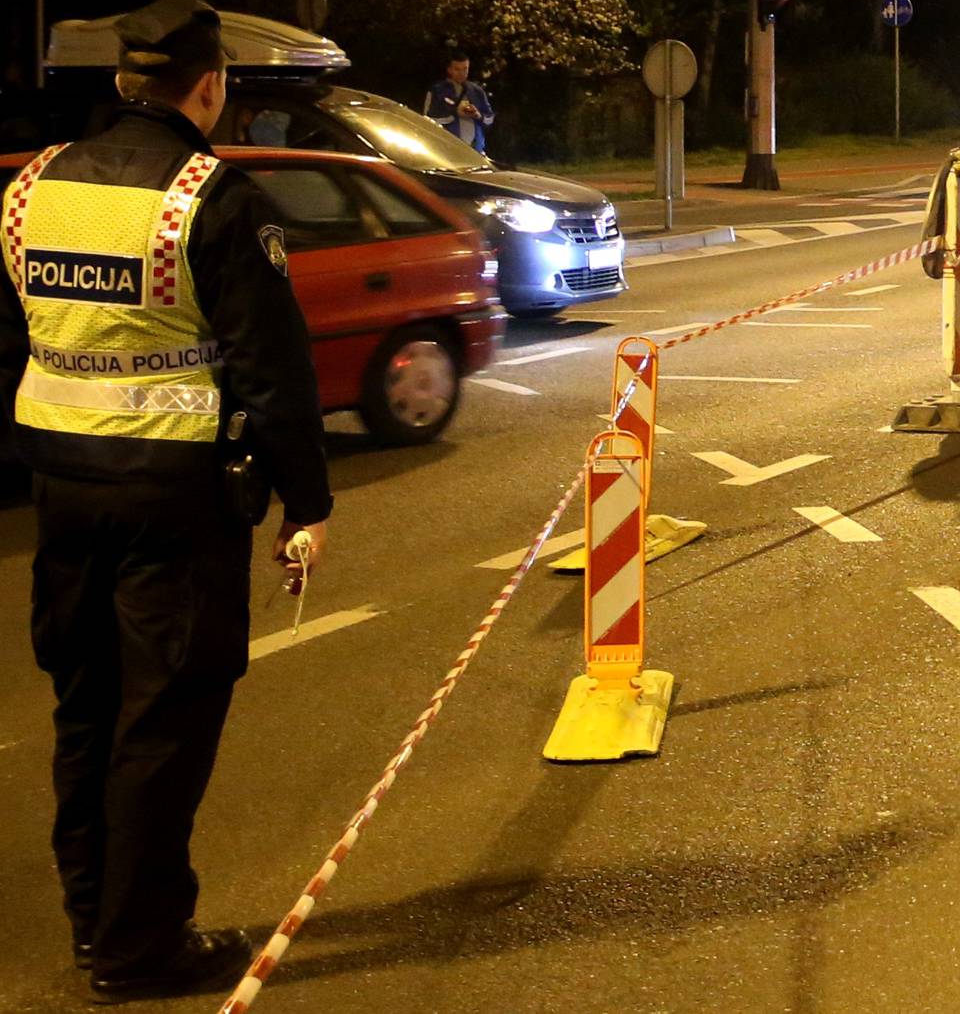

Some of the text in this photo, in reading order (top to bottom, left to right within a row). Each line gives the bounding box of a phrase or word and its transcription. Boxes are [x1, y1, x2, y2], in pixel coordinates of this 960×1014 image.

[28, 261, 135, 293] POLICIJA
[43, 349, 123, 373] POLICIJA
[132, 344, 225, 373] POLICIJA
